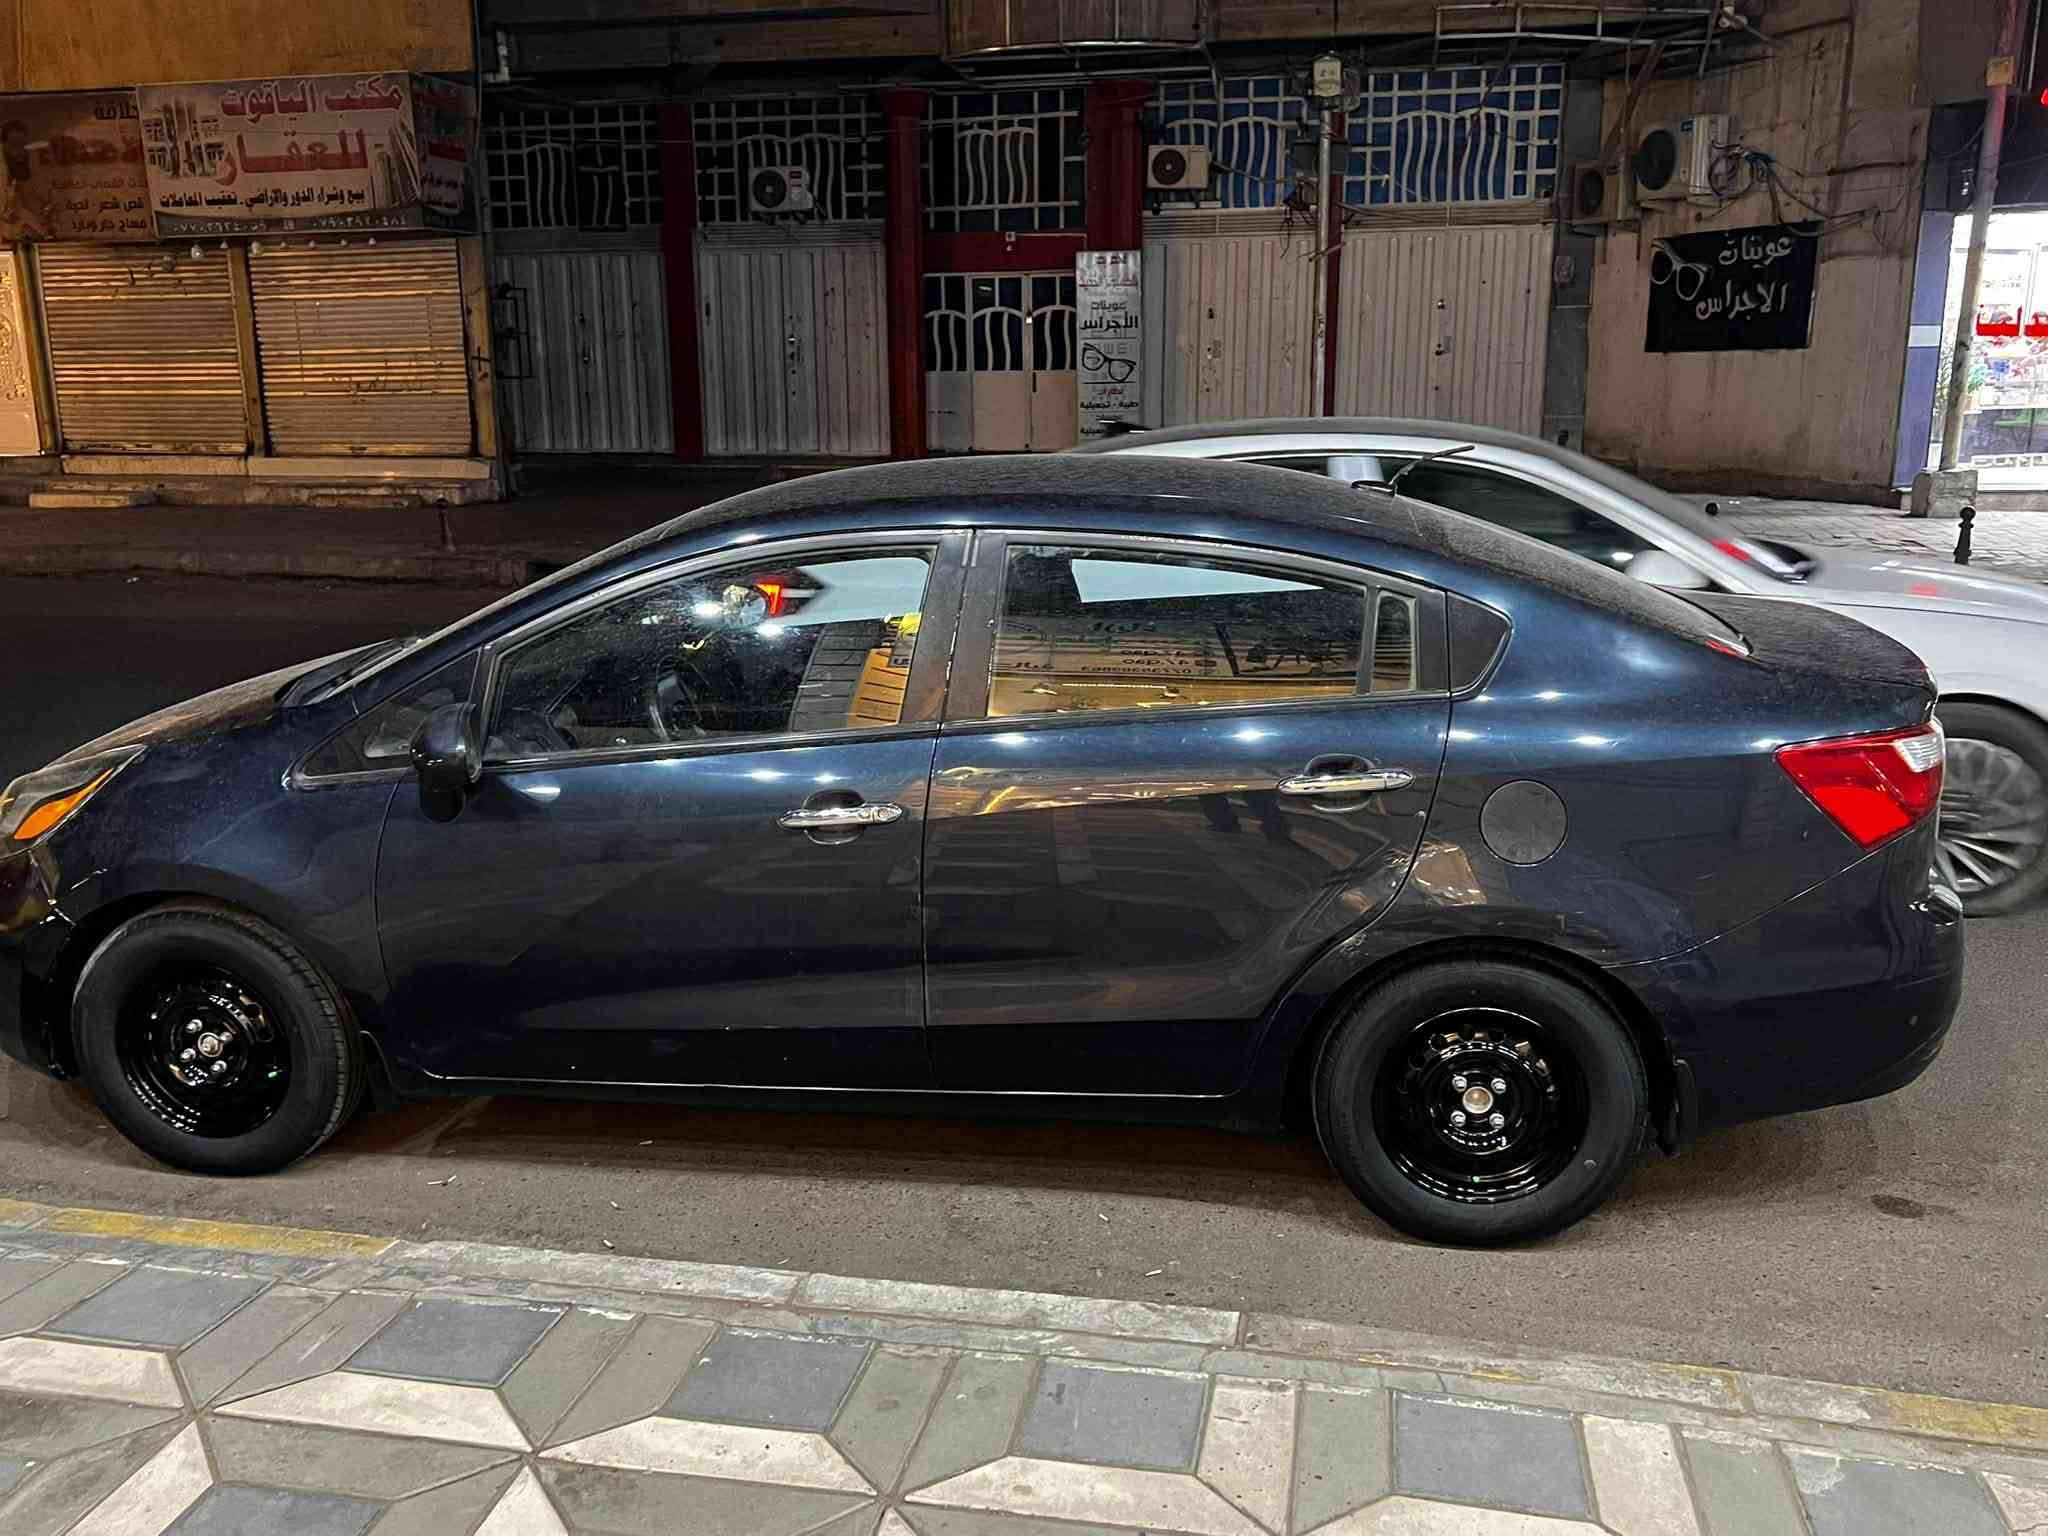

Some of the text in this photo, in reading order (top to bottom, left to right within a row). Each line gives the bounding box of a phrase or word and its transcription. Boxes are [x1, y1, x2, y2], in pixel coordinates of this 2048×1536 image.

[221, 79, 320, 123] الياقوت
[324, 75, 404, 119] مكتب
[214, 128, 369, 186] للعقار
[1718, 235, 1794, 269] عوينات
